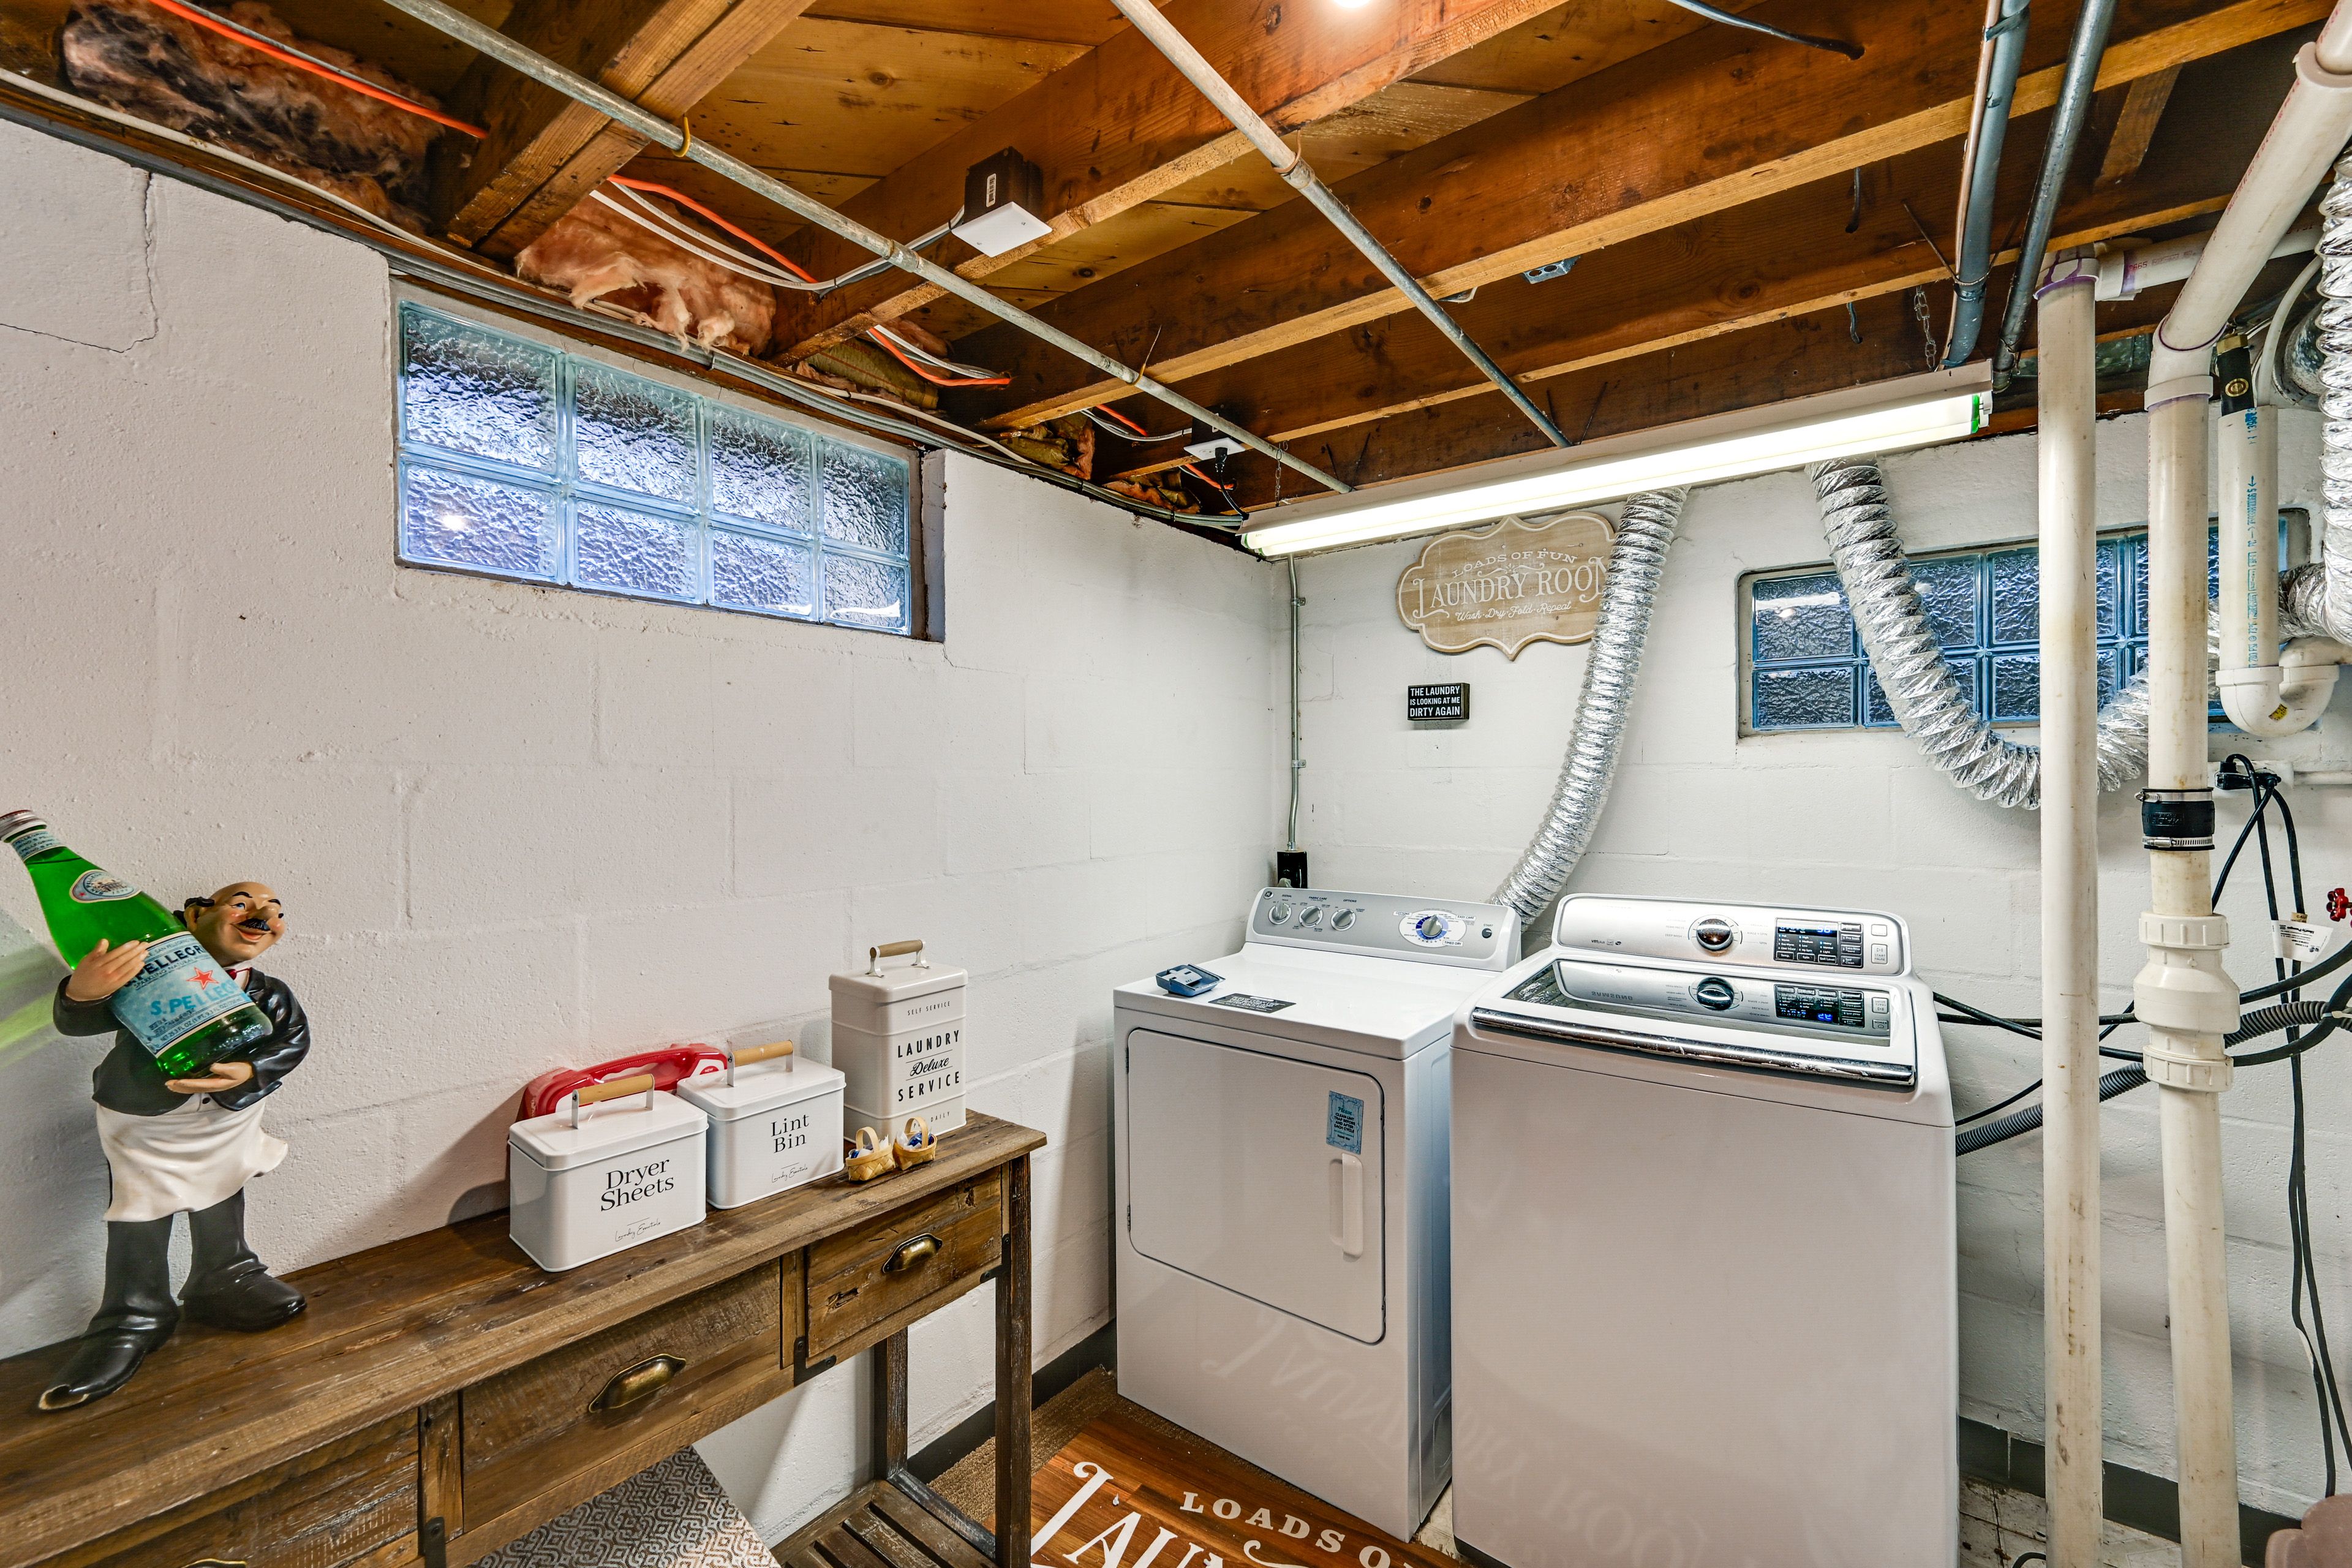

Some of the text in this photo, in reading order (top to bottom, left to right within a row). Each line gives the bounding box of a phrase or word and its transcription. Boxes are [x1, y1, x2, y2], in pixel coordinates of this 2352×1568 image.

[1452, 550, 1578, 578] LOADS OF FUN
[1412, 571, 1529, 619] LAUNDRY
[1455, 601, 1572, 621] Wash Dry Fold Repeat
[1410, 685, 1461, 696] THE LAUNDRY
[1410, 706, 1460, 717] DIRTY AGAIN
[1417, 697, 1442, 706] LOOKING
[133, 959, 195, 989] SPARKLING NATURAL
[926, 1001, 951, 1011] SERVICE
[898, 1030, 959, 1058] LAUNDRY
[910, 1057, 949, 1077] Deluxe
[898, 1071, 959, 1102] SERVICE
[930, 1111, 950, 1122] DAILY
[1338, 1107, 1352, 1115] Please
[771, 1114, 810, 1137] Lint
[774, 1134, 807, 1153] Bin
[606, 1159, 670, 1190] Dryer
[772, 1164, 808, 1183] Laundry Essentials
[601, 1177, 674, 1212] Sheets
[615, 1218, 661, 1242] Laundry Essentials
[1180, 1491, 1414, 1568] LOADS O
